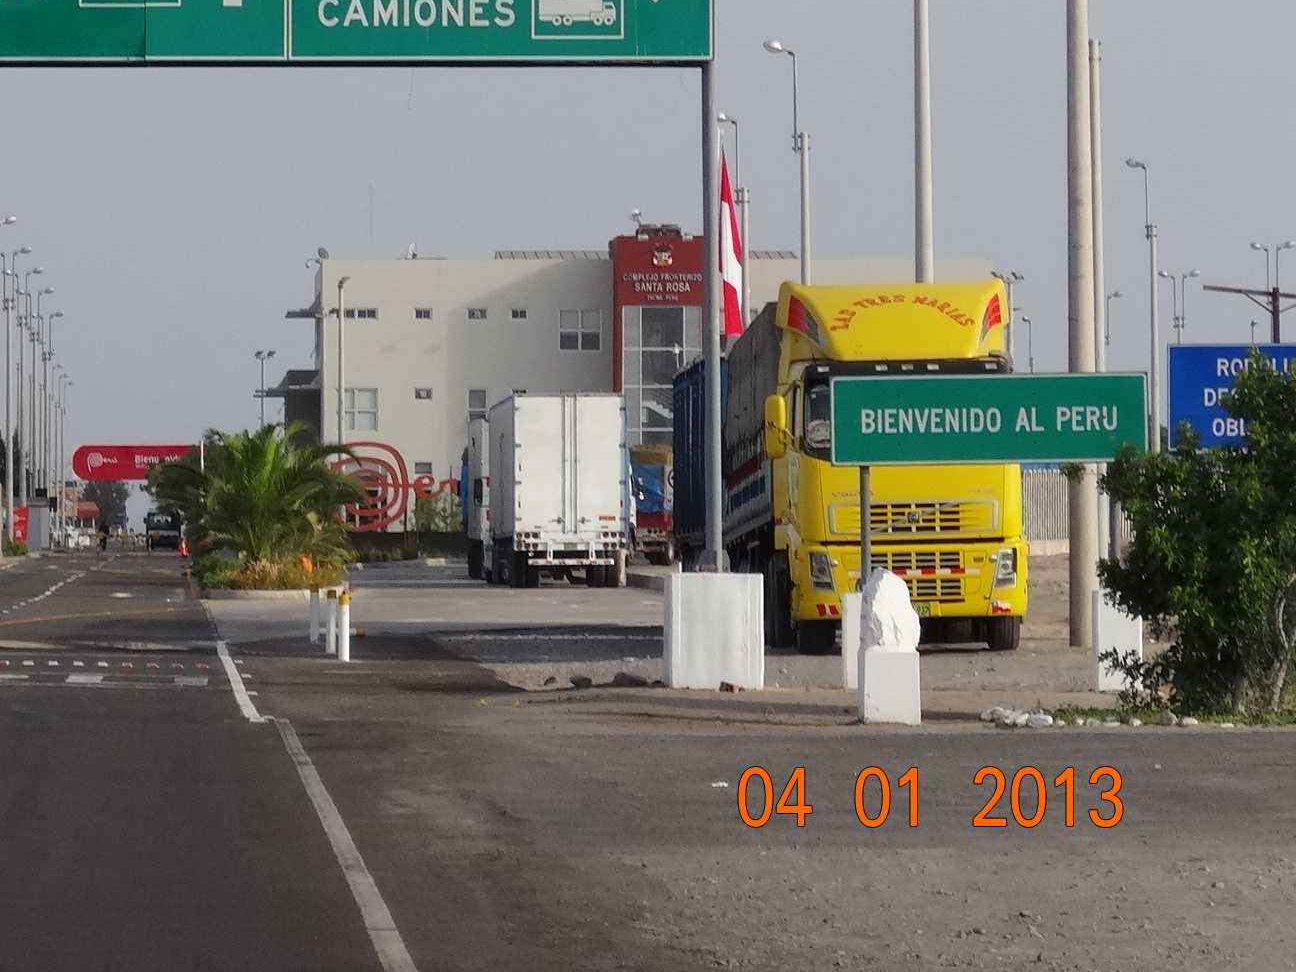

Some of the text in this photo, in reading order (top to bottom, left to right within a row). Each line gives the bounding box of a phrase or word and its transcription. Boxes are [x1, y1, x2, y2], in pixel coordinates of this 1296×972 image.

[634, 282, 691, 293] SANTA ROSA
[860, 405, 1118, 433] BIENVENIDO AL PERU
